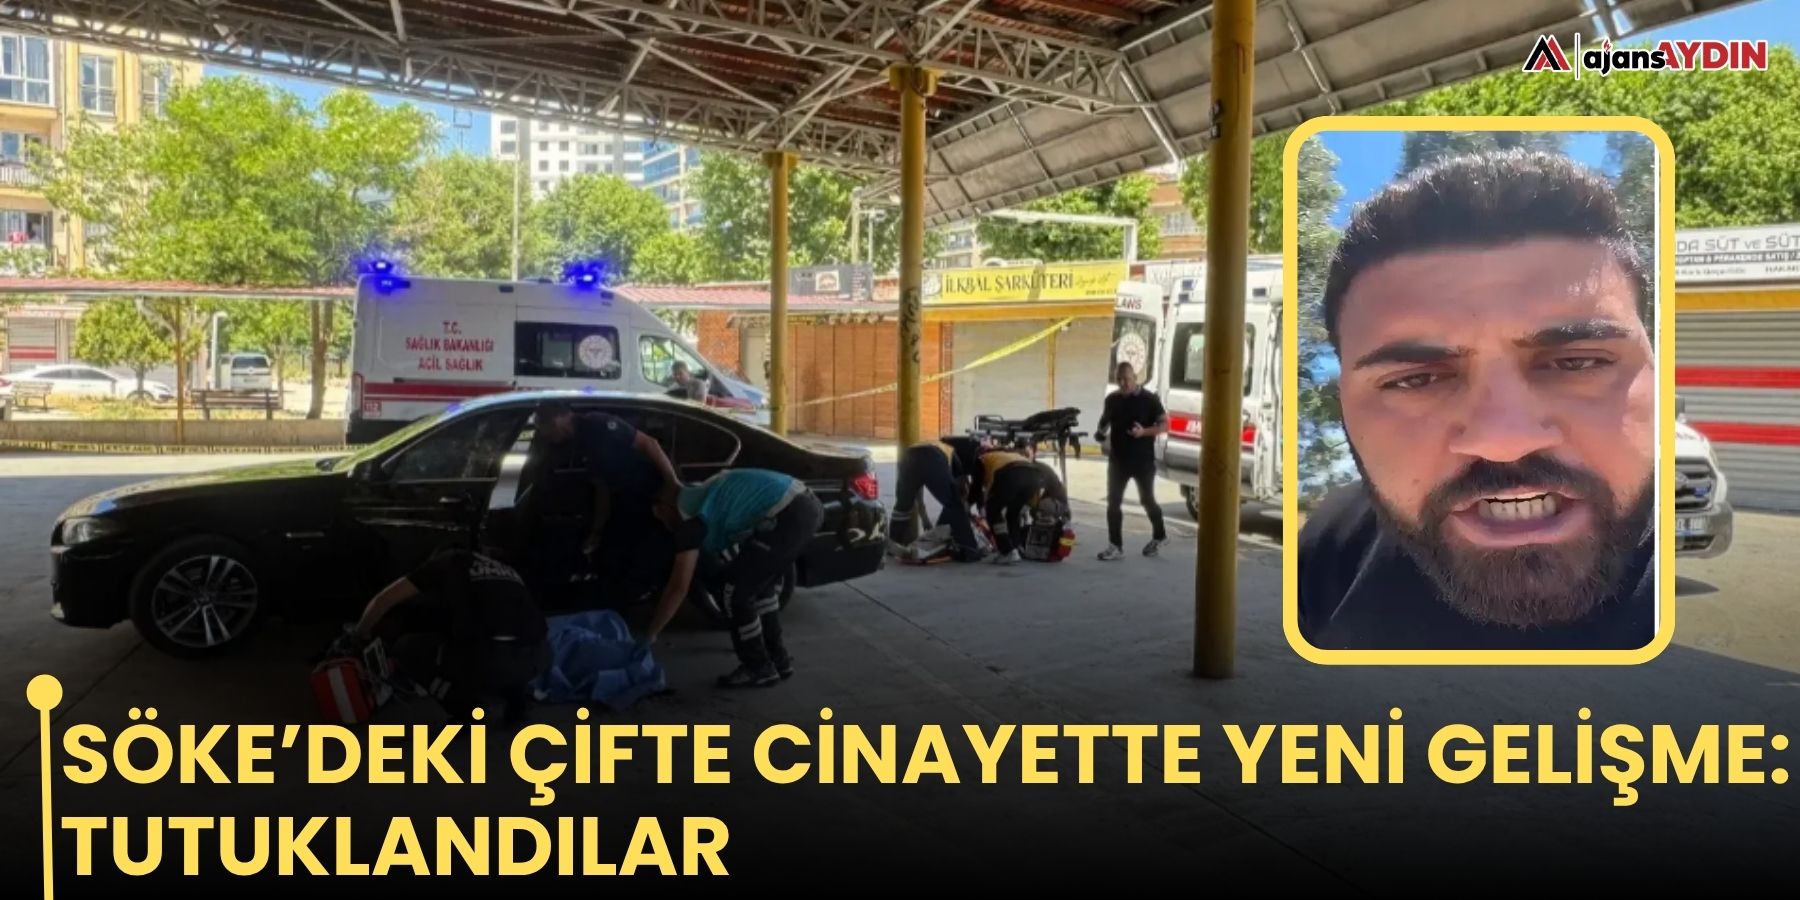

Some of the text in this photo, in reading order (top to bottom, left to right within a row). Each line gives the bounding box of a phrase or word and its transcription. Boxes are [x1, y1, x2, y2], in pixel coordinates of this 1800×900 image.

[1705, 235, 1740, 252] SÜT
[405, 336, 494, 352] SAĞLIK BAKANLIĞI
[418, 356, 483, 371] ACİL SAĞLIK
